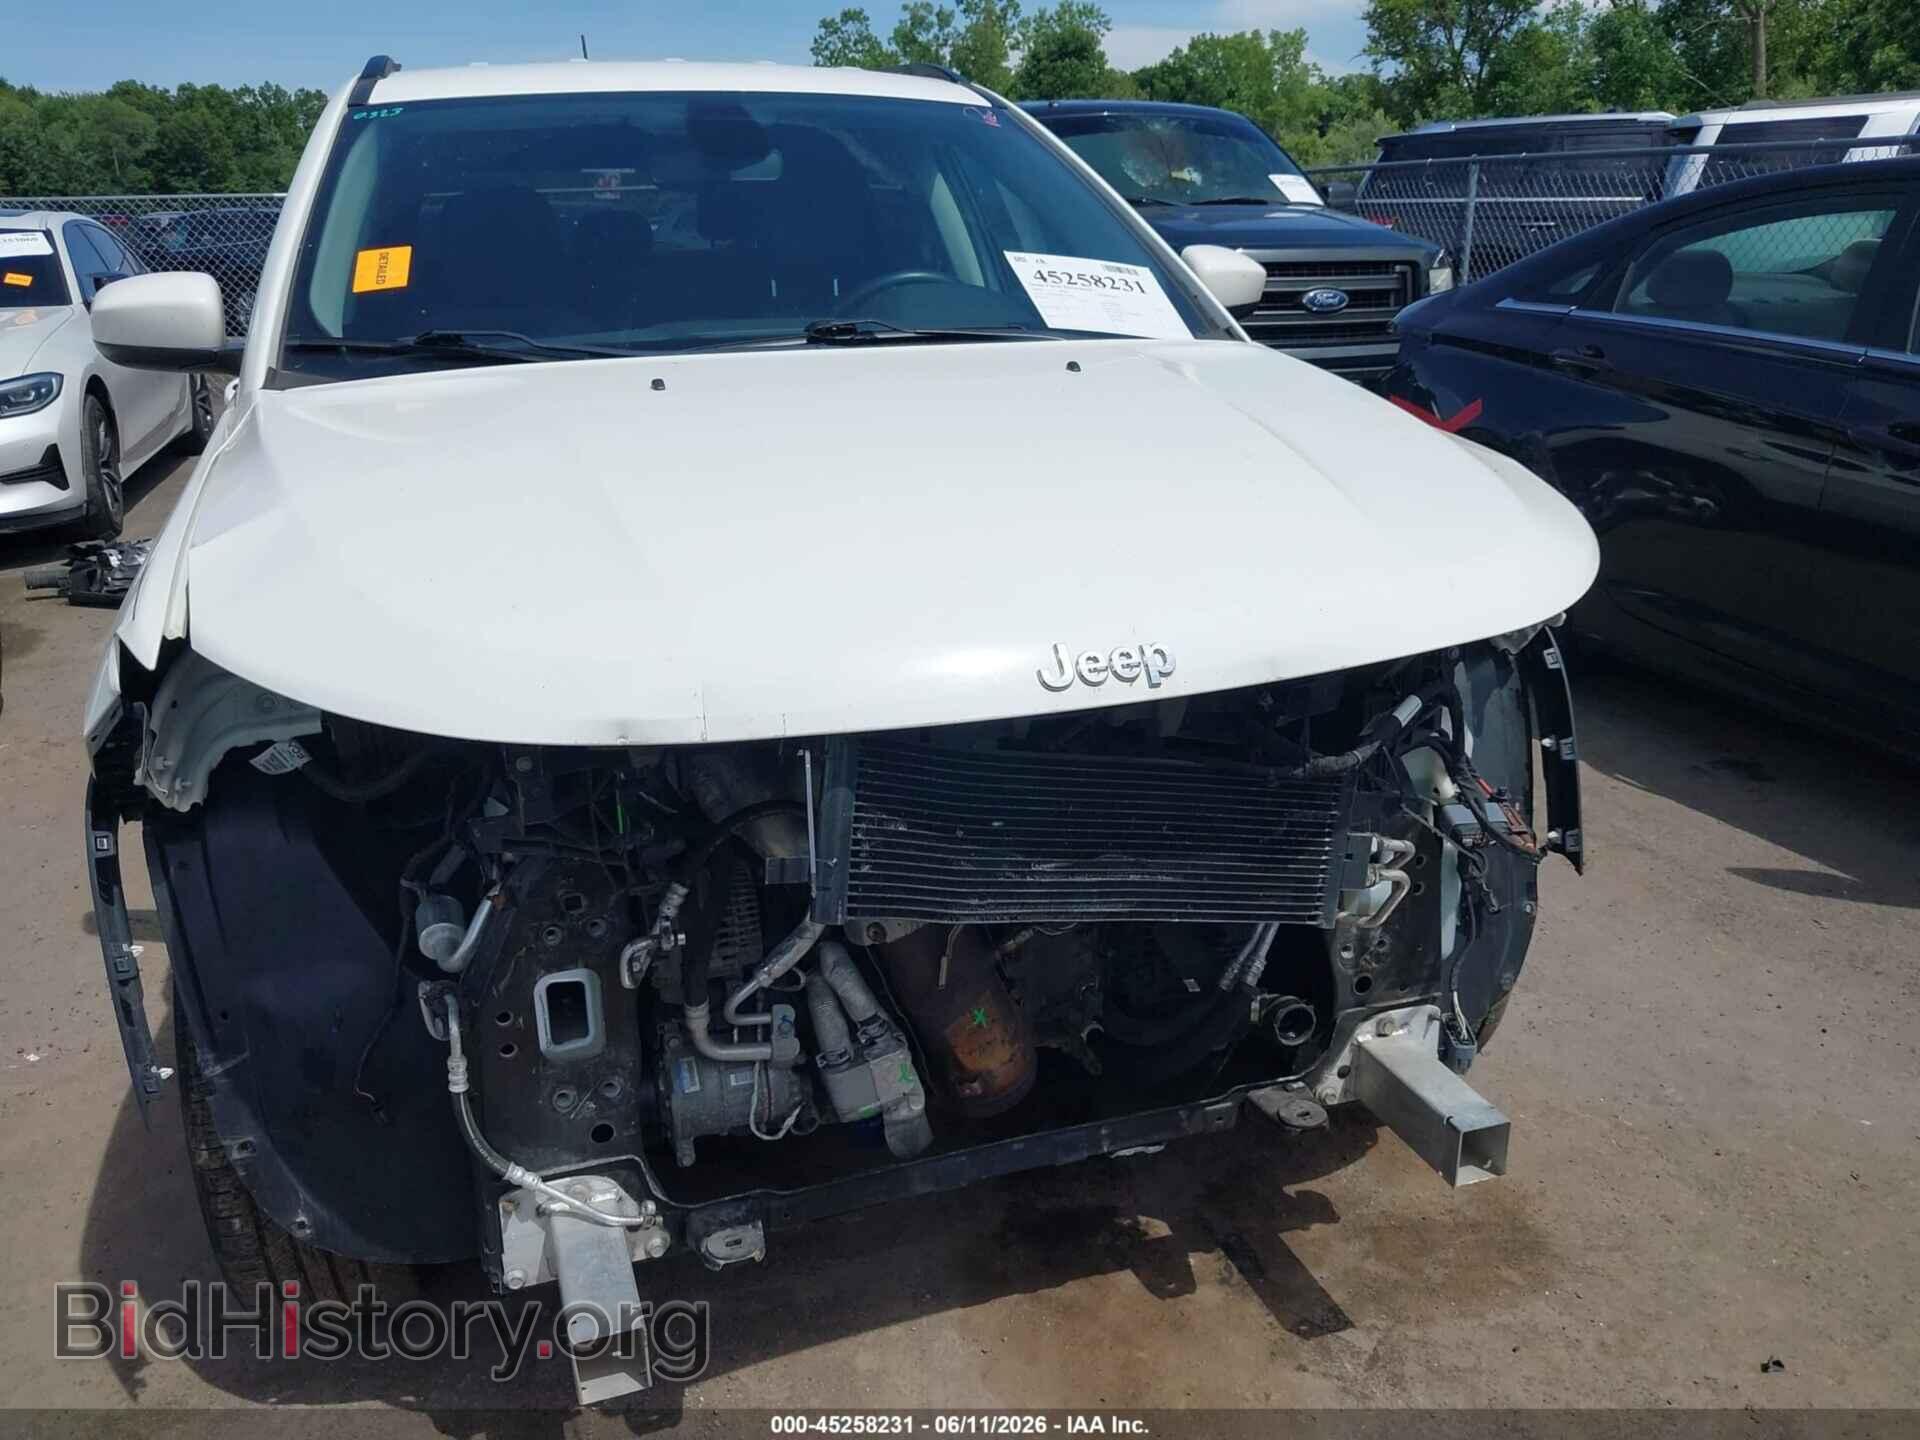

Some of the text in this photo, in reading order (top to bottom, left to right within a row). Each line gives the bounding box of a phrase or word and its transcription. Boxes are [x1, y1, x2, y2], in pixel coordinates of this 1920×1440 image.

[375, 251, 390, 286] DETAILED
[1033, 269, 1146, 295] 45258231
[1313, 293, 1341, 305] Ford
[1035, 641, 1177, 693] Jeep
